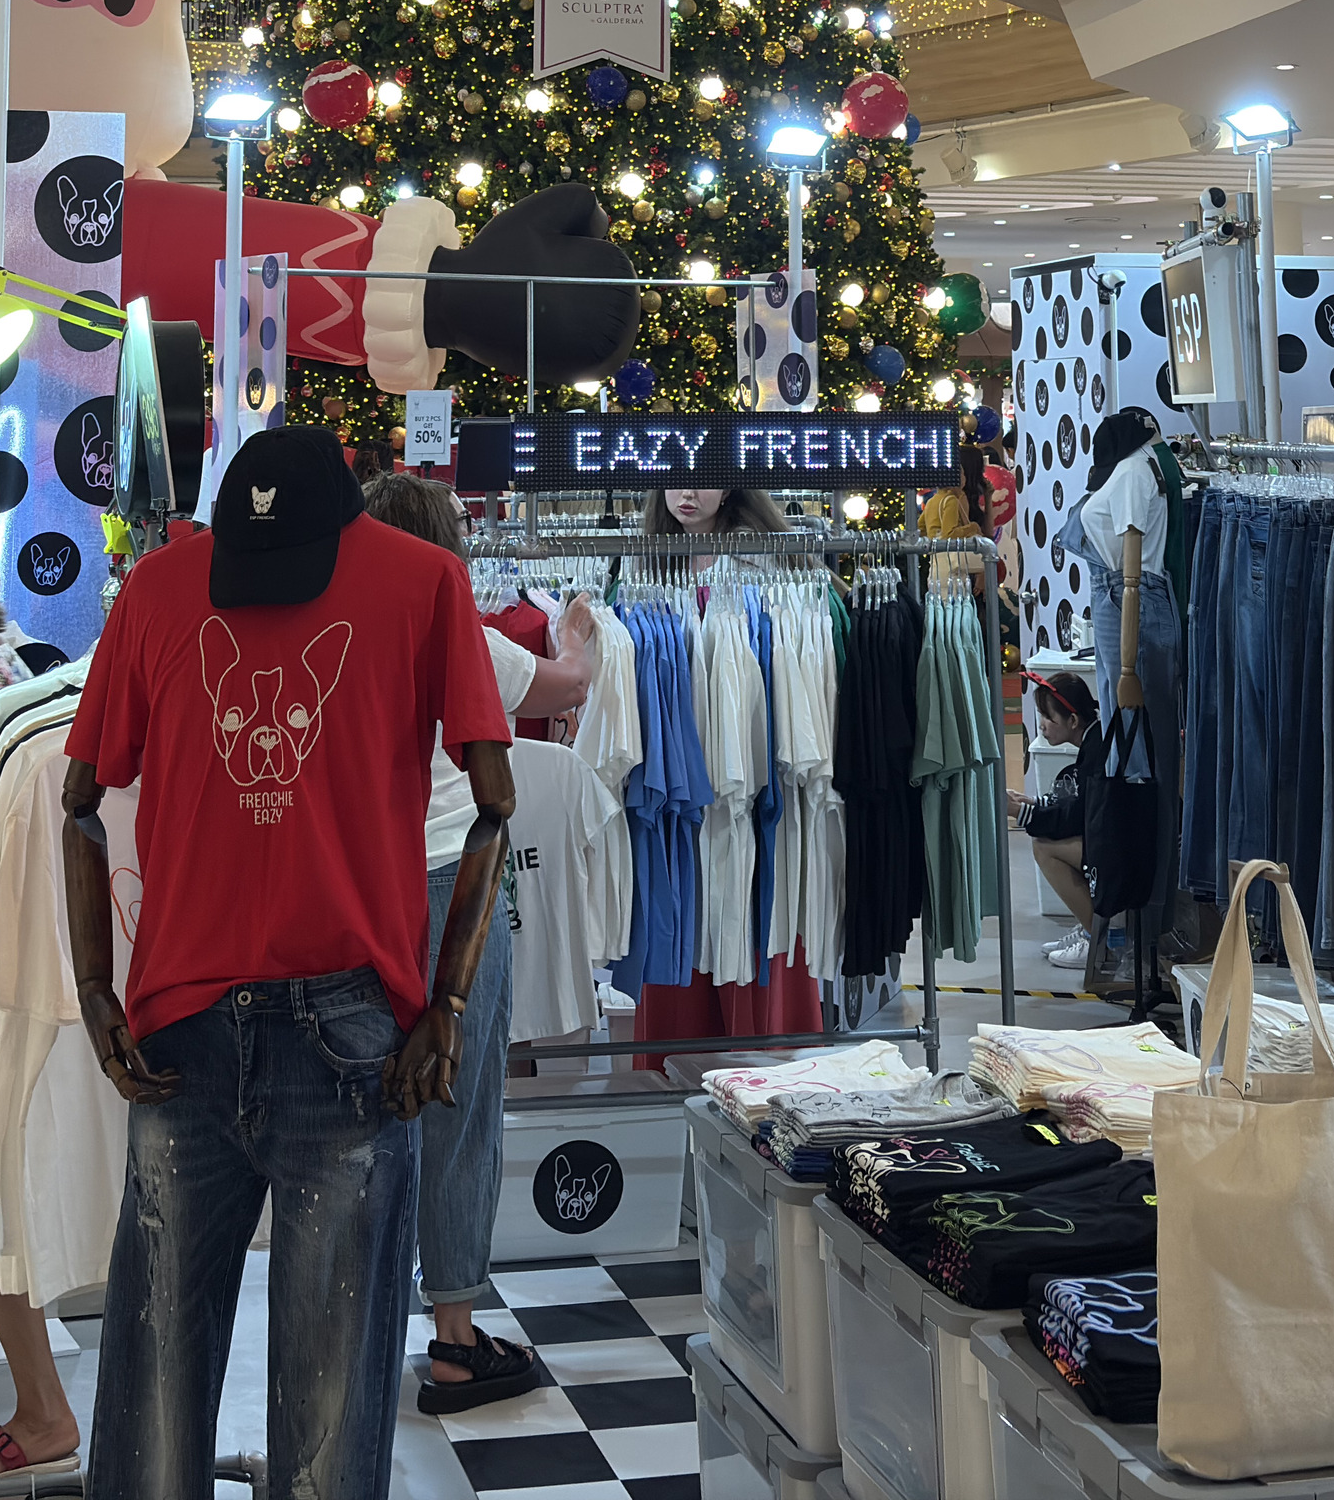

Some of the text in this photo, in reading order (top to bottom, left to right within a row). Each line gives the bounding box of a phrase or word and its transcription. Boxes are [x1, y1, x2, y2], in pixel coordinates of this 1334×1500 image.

[596, 17, 644, 25] GALDERMA
[1171, 293, 1202, 364] ESP
[414, 430, 442, 444] 50%
[576, 429, 709, 471] EAZY
[738, 429, 953, 471] FRENCHI
[239, 791, 295, 809] FRENCHIE
[254, 807, 284, 825] EAZY
